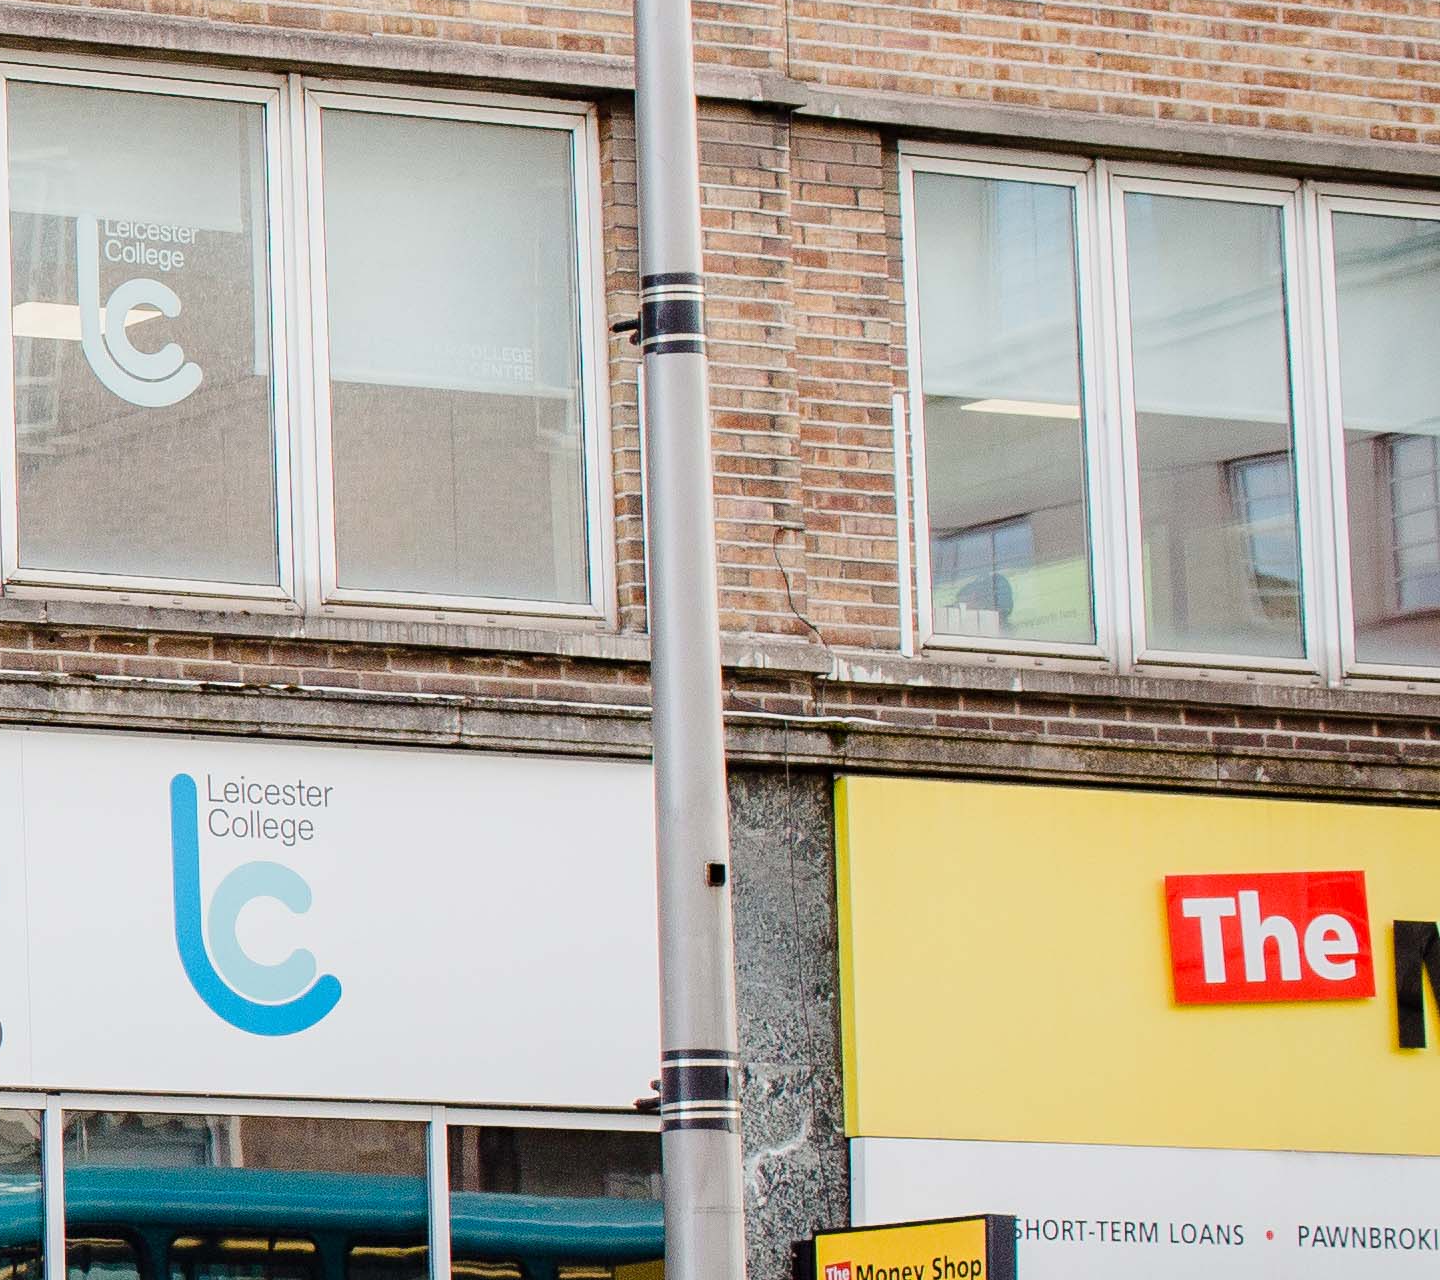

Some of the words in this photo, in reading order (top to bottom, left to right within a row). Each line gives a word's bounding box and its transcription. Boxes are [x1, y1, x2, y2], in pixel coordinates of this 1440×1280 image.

[104, 219, 199, 244] Leicester
[105, 240, 184, 271] College
[207, 773, 333, 809] Leicester
[209, 809, 314, 847] College
[1182, 890, 1359, 984] The
[1014, 1219, 1158, 1244] SHORT-TERM
[1170, 1223, 1244, 1246] LOANS
